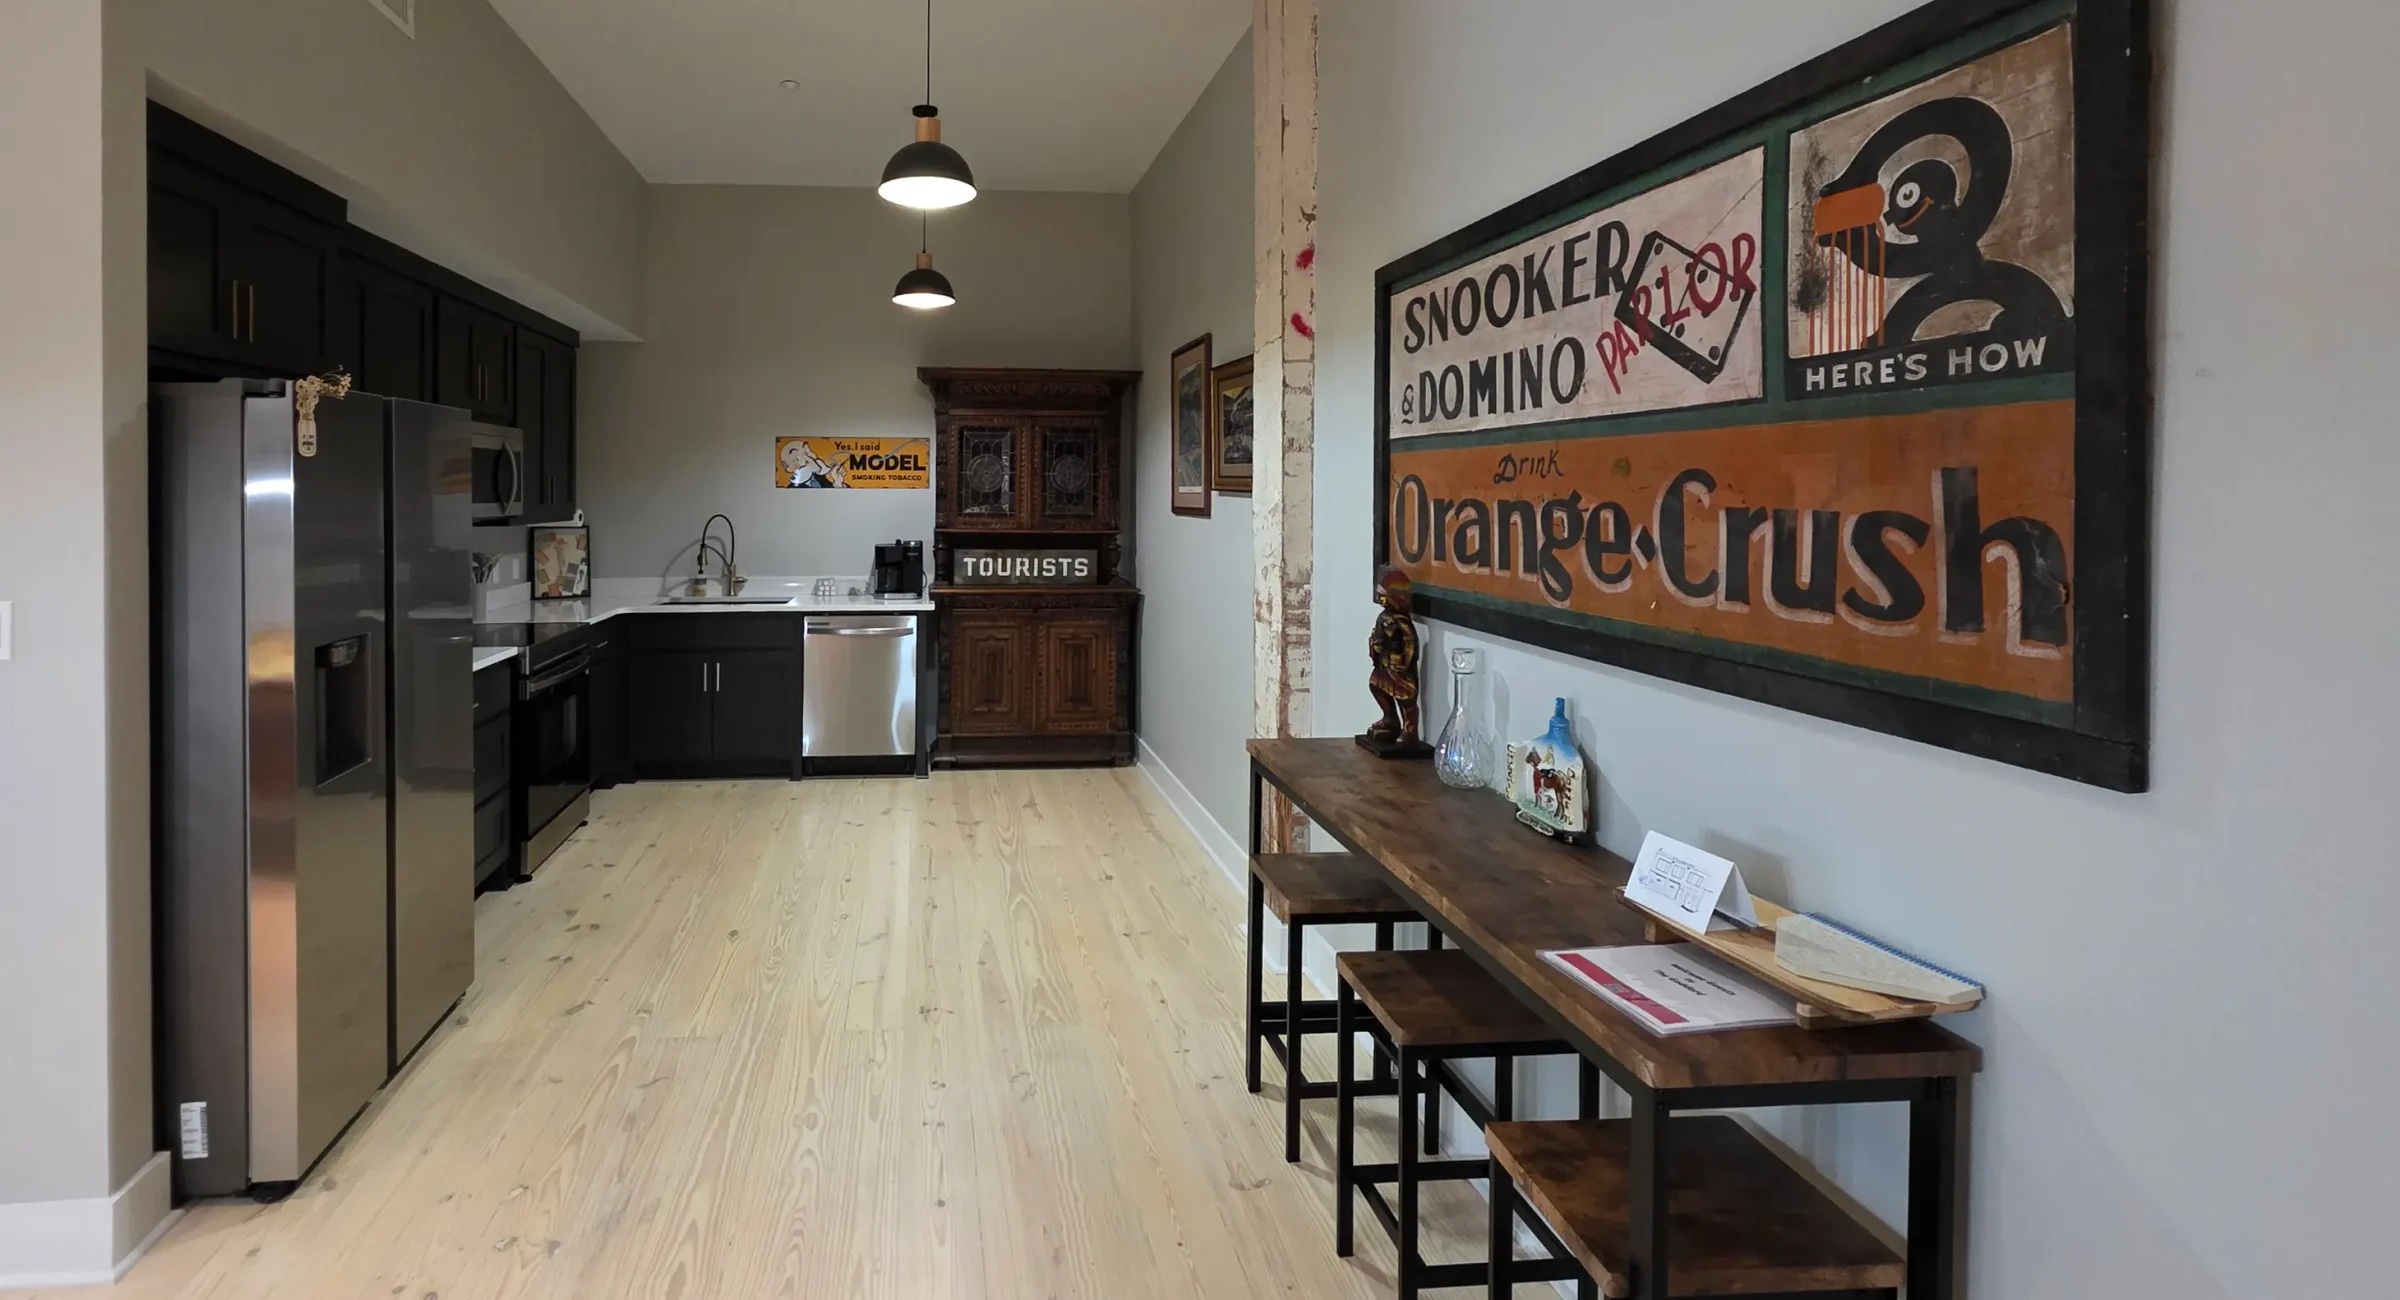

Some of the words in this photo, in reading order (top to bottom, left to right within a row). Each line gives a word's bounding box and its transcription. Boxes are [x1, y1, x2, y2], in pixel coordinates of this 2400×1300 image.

[1404, 220, 1630, 354] SNOOKER
[1596, 232, 1757, 395] PARLOR
[1418, 336, 1586, 425] DOMINO
[1805, 353, 1928, 392] HERE'S
[1948, 336, 2047, 376] HOW
[849, 454, 926, 471] MODEL
[860, 441, 880, 451] said
[1493, 450, 1565, 484] Drink
[963, 557, 1089, 577] TOURISTS
